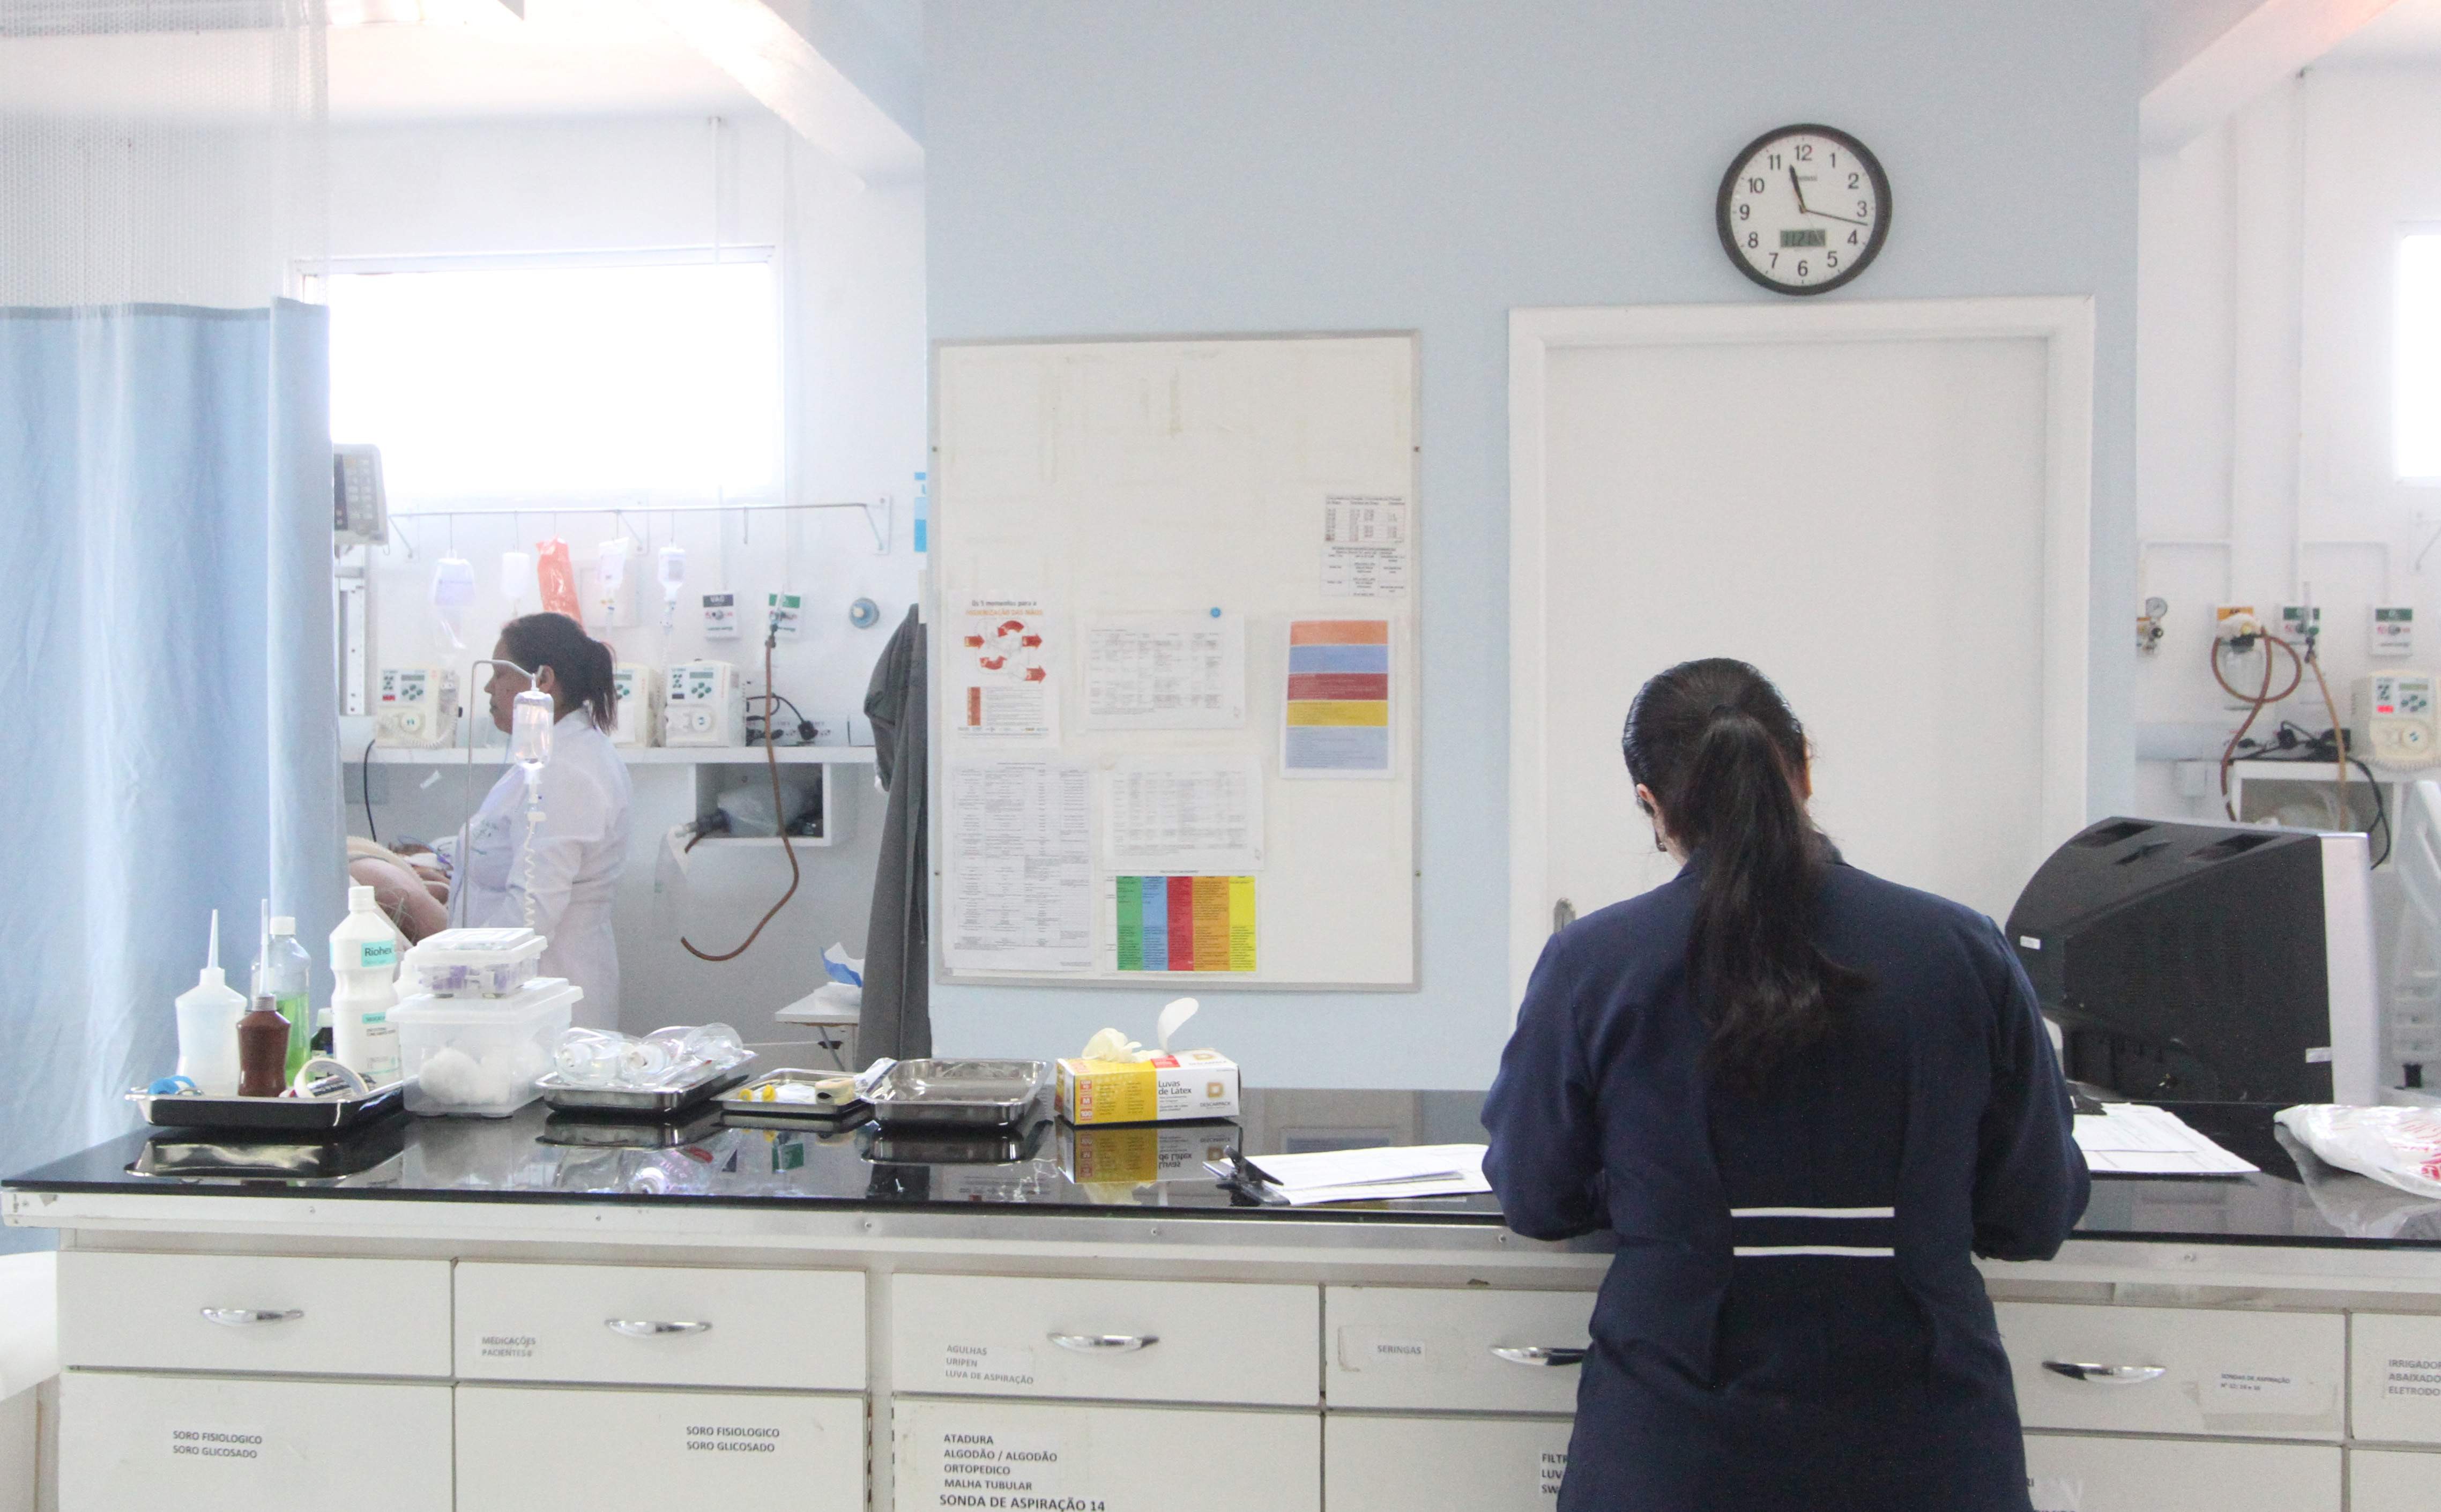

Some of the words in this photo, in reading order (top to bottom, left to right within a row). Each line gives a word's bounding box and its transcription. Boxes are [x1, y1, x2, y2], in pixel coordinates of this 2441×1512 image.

[1793, 145, 1812, 161] 12
[1829, 152, 1836, 168] 1
[1768, 154, 1781, 170] 11
[1747, 177, 1765, 193] 10
[1848, 173, 1859, 190] 2
[1739, 204, 1750, 220] 9
[1856, 201, 1867, 218] 3
[1747, 232, 1759, 249] 8
[1847, 229, 1858, 245] 4
[1769, 252, 1778, 269] 7
[1827, 251, 1837, 267] 5
[1797, 260, 1808, 277] 6
[947, 1345, 987, 1356] AGULHAS
[1377, 1345, 1422, 1355] SERINGAS
[946, 1358, 978, 1367] URIPEN
[945, 1370, 968, 1378] LUVA
[970, 1372, 981, 1380] DE
[984, 1373, 1034, 1385] ASPIRAÇÃO
[2388, 1386, 2441, 1396] ELETRODO
[173, 1431, 200, 1441] SORO
[202, 1432, 263, 1445] FISIOLOGICO
[686, 1426, 714, 1436] SORO
[717, 1427, 780, 1438] FISIOLOGICO
[944, 1434, 994, 1444] ATADURA
[173, 1445, 199, 1455] SORO
[202, 1447, 258, 1459] GLICOSADO
[687, 1441, 715, 1451] SORO
[717, 1442, 775, 1453] GLICOSADO
[944, 1448, 995, 1459] ALGODÃO
[1006, 1451, 1058, 1462] ALGODÃO
[944, 1464, 1010, 1475] ORTOPEDICO
[1542, 1469, 1563, 1479] LUV
[944, 1479, 982, 1488] MALHA
[985, 1480, 1032, 1491] TUBULAR
[1542, 1484, 1559, 1494] SW
[940, 1494, 986, 1507] SONDA
[990, 1497, 1006, 1508] DE
[1010, 1497, 1086, 1512] ASPIRAÇÃO
[1091, 1501, 1105, 1511] 14
